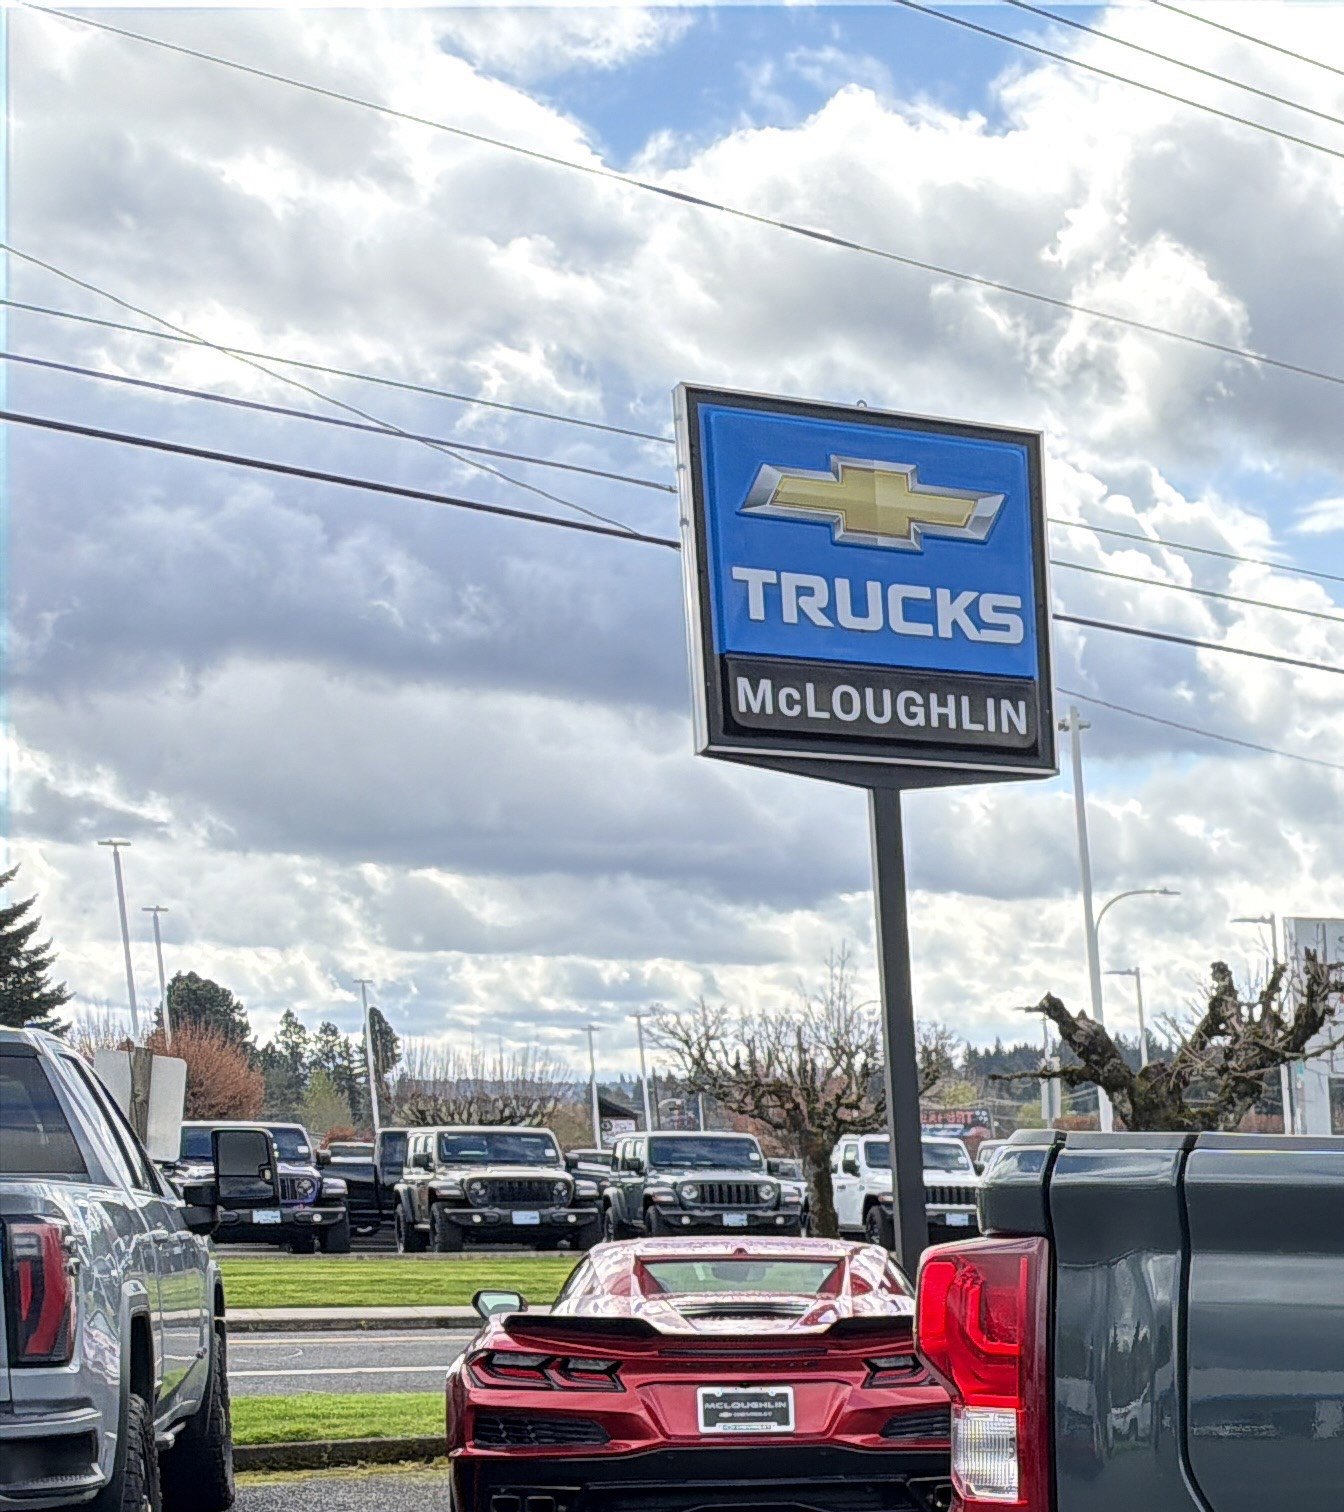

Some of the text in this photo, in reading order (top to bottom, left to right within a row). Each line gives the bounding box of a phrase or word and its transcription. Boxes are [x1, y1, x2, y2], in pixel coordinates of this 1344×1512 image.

[732, 566, 1024, 645] TRUCKS
[736, 676, 1027, 735] McLOUGHLIN
[704, 1401, 787, 1410] MCLOUGHLIN
